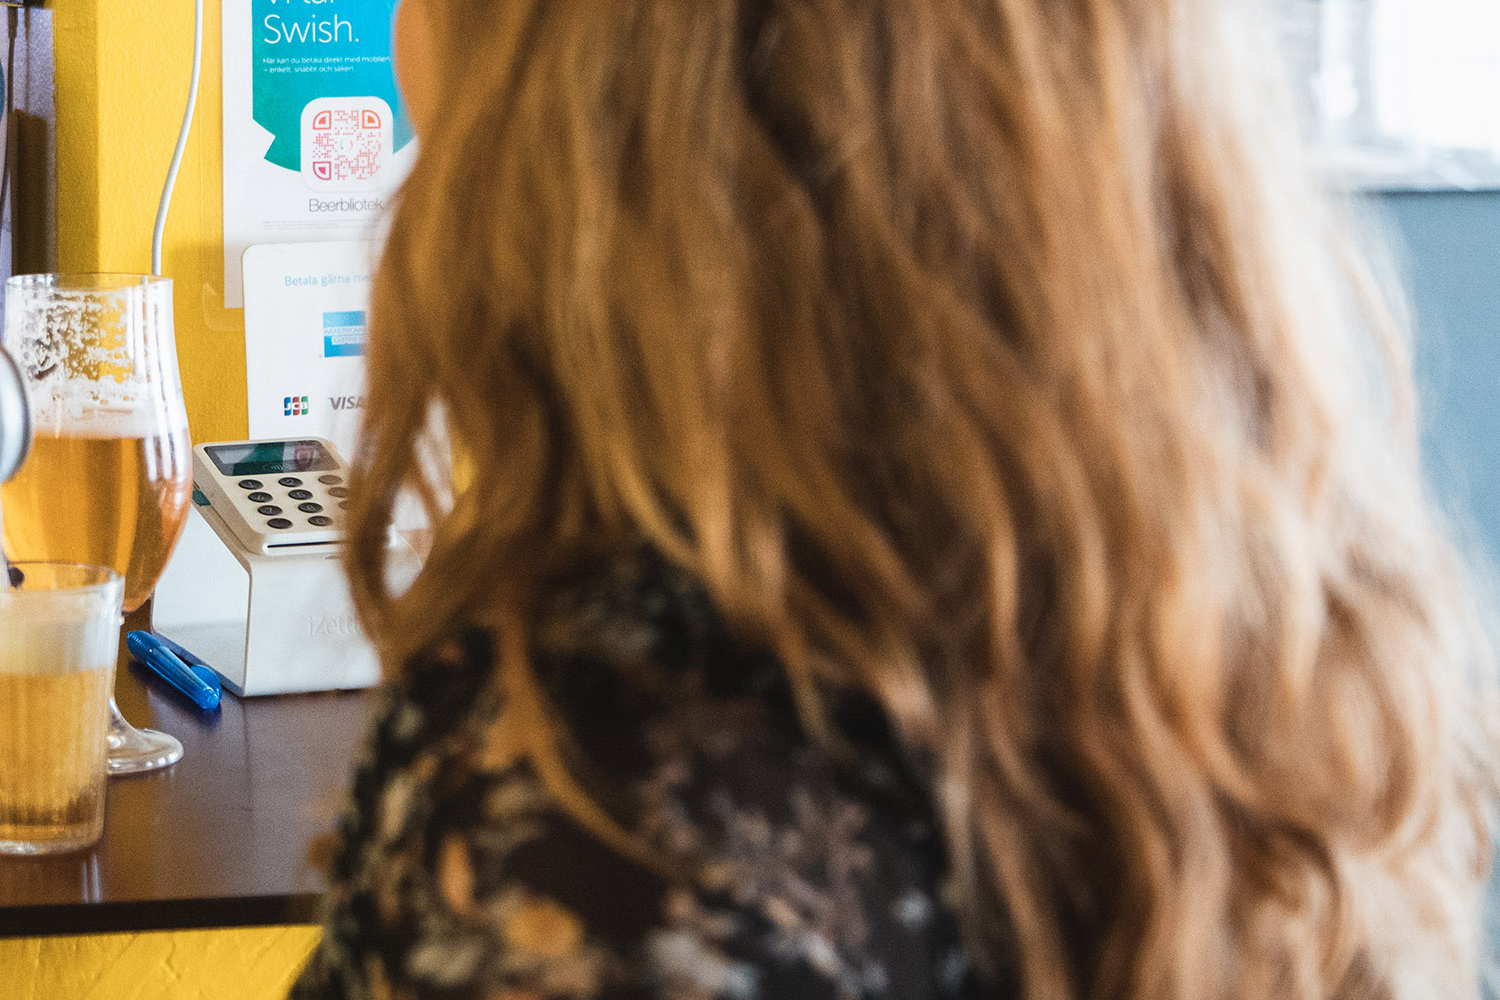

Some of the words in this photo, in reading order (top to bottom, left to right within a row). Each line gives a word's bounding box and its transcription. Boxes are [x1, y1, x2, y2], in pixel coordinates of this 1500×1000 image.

[263, 13, 360, 44] Swish.
[319, 65, 333, 73] och
[308, 198, 384, 212] Beerbliotek
[284, 275, 318, 287] Betala
[321, 273, 351, 287] gärna
[354, 274, 369, 283] me
